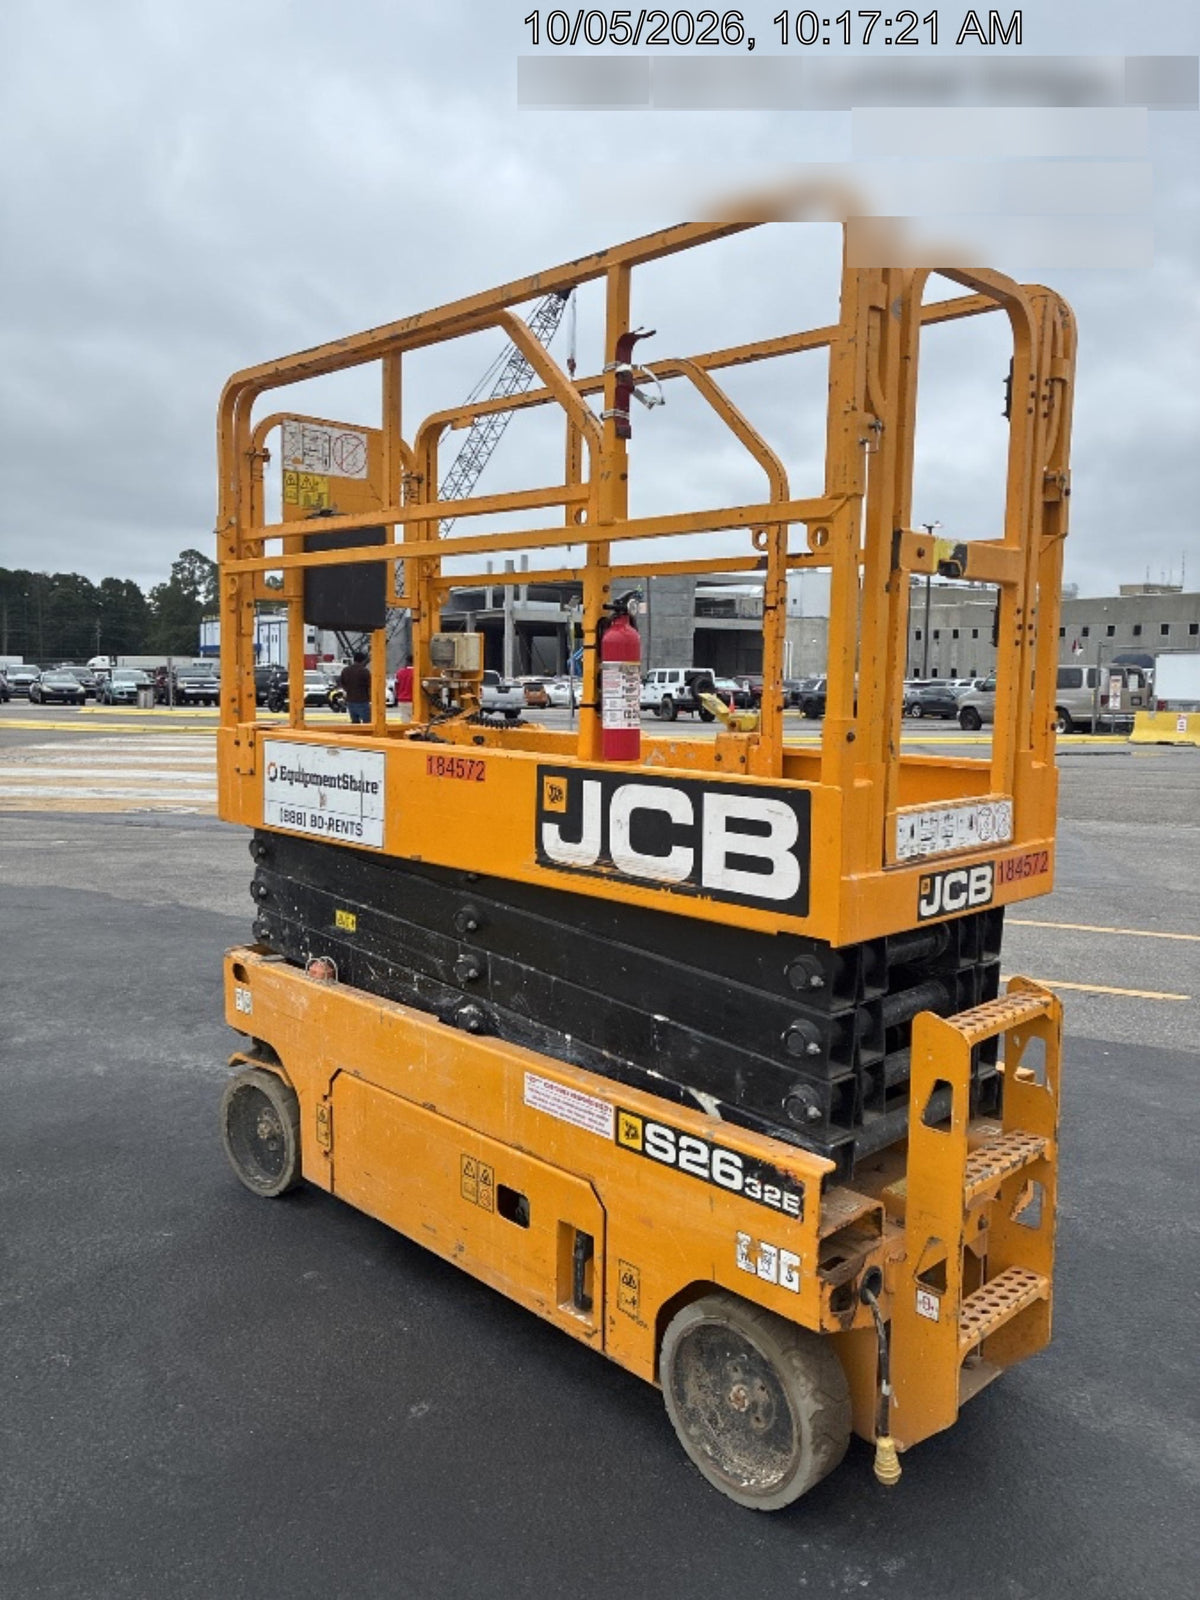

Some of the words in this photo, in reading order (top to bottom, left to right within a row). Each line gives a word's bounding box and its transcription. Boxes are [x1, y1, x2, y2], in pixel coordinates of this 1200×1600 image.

[280, 766, 379, 794] EquipmentShare
[427, 756, 485, 781] 184572
[541, 780, 801, 900] JCB
[998, 851, 1049, 884] 184572
[919, 865, 993, 916] JCB
[644, 1123, 744, 1190] S26
